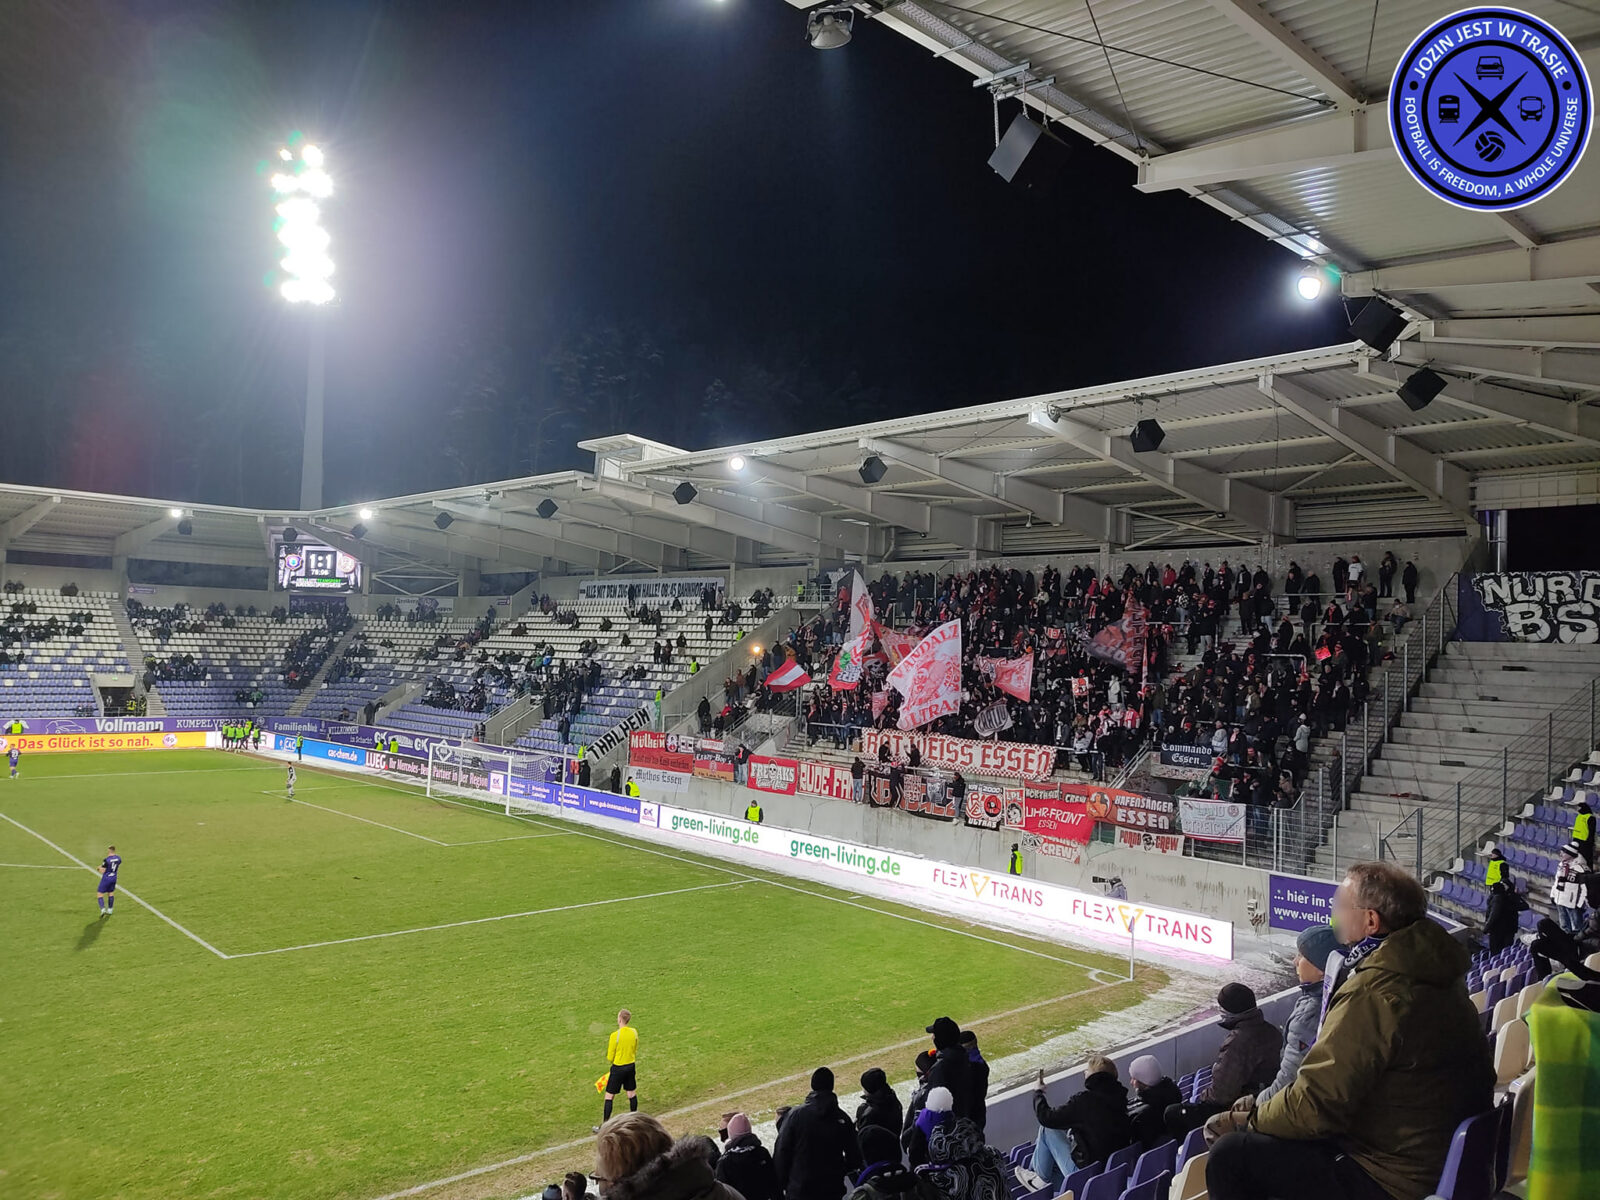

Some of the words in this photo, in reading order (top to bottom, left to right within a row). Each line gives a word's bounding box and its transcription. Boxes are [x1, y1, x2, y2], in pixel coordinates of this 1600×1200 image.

[310, 554, 332, 569] 1:1
[1483, 576, 1578, 604] NUR
[892, 624, 958, 678] VANDALZ
[95, 718, 164, 732] Vollmann
[587, 707, 650, 760] THALHEIM
[18, 738, 44, 749] Das
[48, 737, 85, 749] Glück
[89, 737, 104, 747] ist
[127, 736, 153, 746] nah.
[1162, 743, 1212, 754] Commando
[980, 744, 1050, 774] ESSEN
[1172, 753, 1199, 764] Essen
[636, 769, 660, 783] Mythos
[800, 763, 831, 794] RUDE
[1007, 792, 1021, 800] LPL
[968, 818, 997, 828] ULTRAS
[1038, 820, 1057, 830] ESSEN
[1117, 808, 1170, 829] ESSEN
[672, 813, 759, 844] green-living.de
[1042, 842, 1072, 858] CREW
[1155, 835, 1179, 853] CREW
[790, 839, 900, 876] green-living.de
[934, 868, 967, 889] FLEX
[992, 881, 1043, 907] TRANS
[1287, 890, 1308, 904] hier
[1312, 894, 1326, 908] im
[1072, 900, 1115, 922] FLEX
[1145, 915, 1212, 944] TRANS
